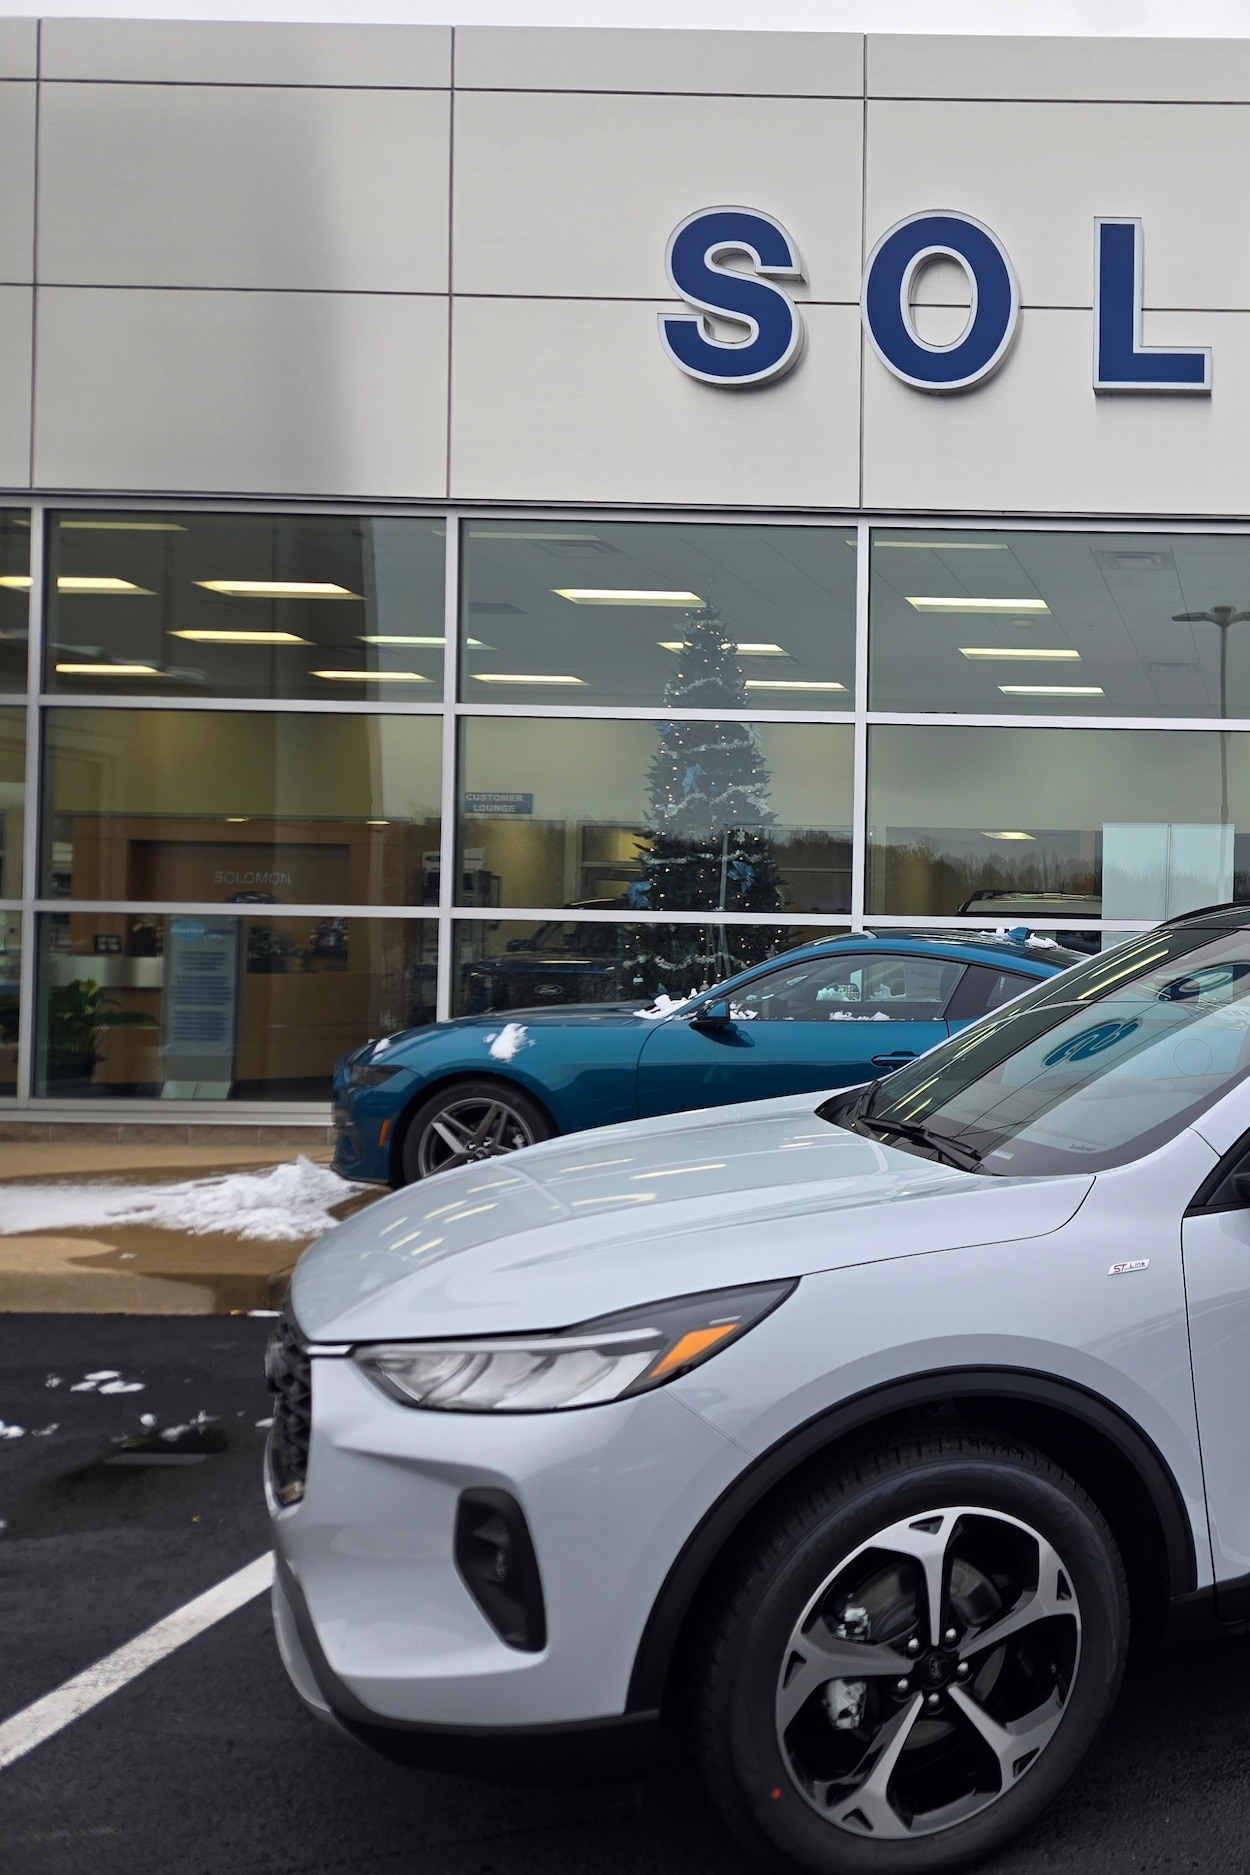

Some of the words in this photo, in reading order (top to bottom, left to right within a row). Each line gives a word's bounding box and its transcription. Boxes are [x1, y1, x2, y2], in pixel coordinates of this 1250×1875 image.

[465, 793, 525, 802] CUSTOMER
[472, 804, 518, 813] LOUNGE
[214, 870, 292, 885] SOLOMON
